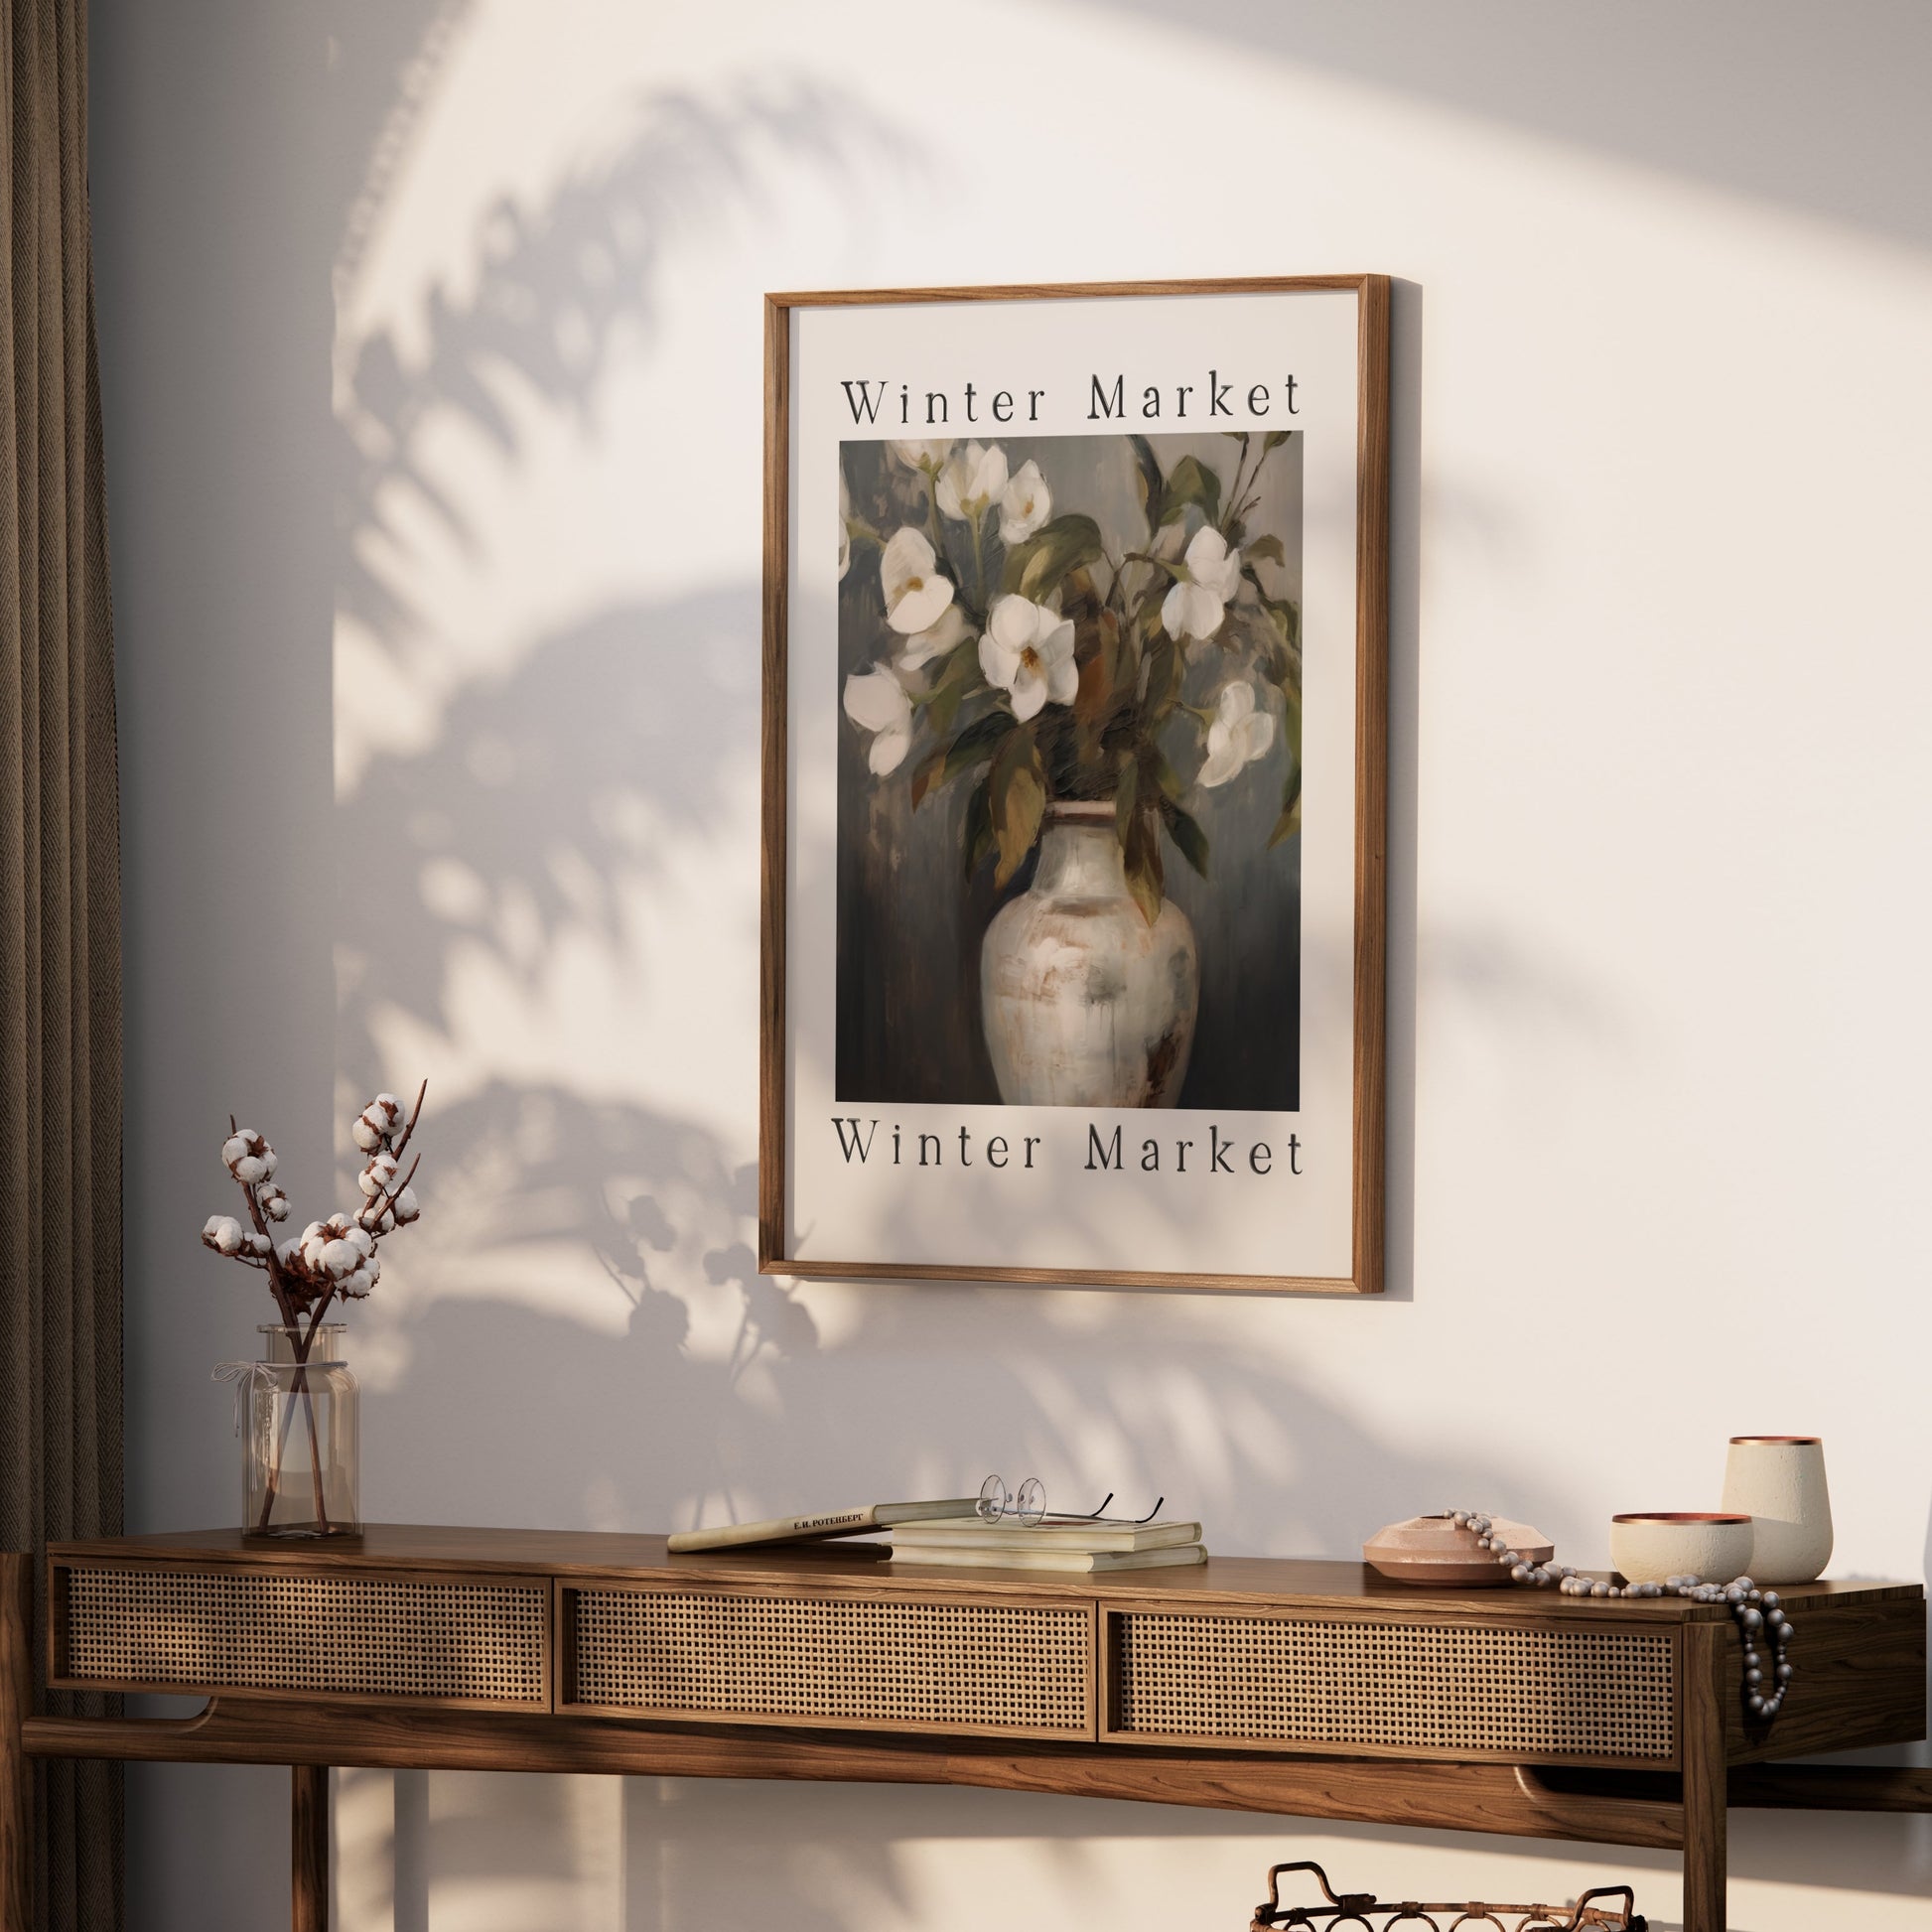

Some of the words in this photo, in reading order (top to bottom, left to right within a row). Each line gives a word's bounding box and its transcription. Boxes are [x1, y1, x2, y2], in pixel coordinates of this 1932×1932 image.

[840, 380, 1045, 425] Winter
[1087, 370, 1300, 419] Market
[830, 1119, 1041, 1169] Winter
[1083, 1124, 1303, 1175] Market
